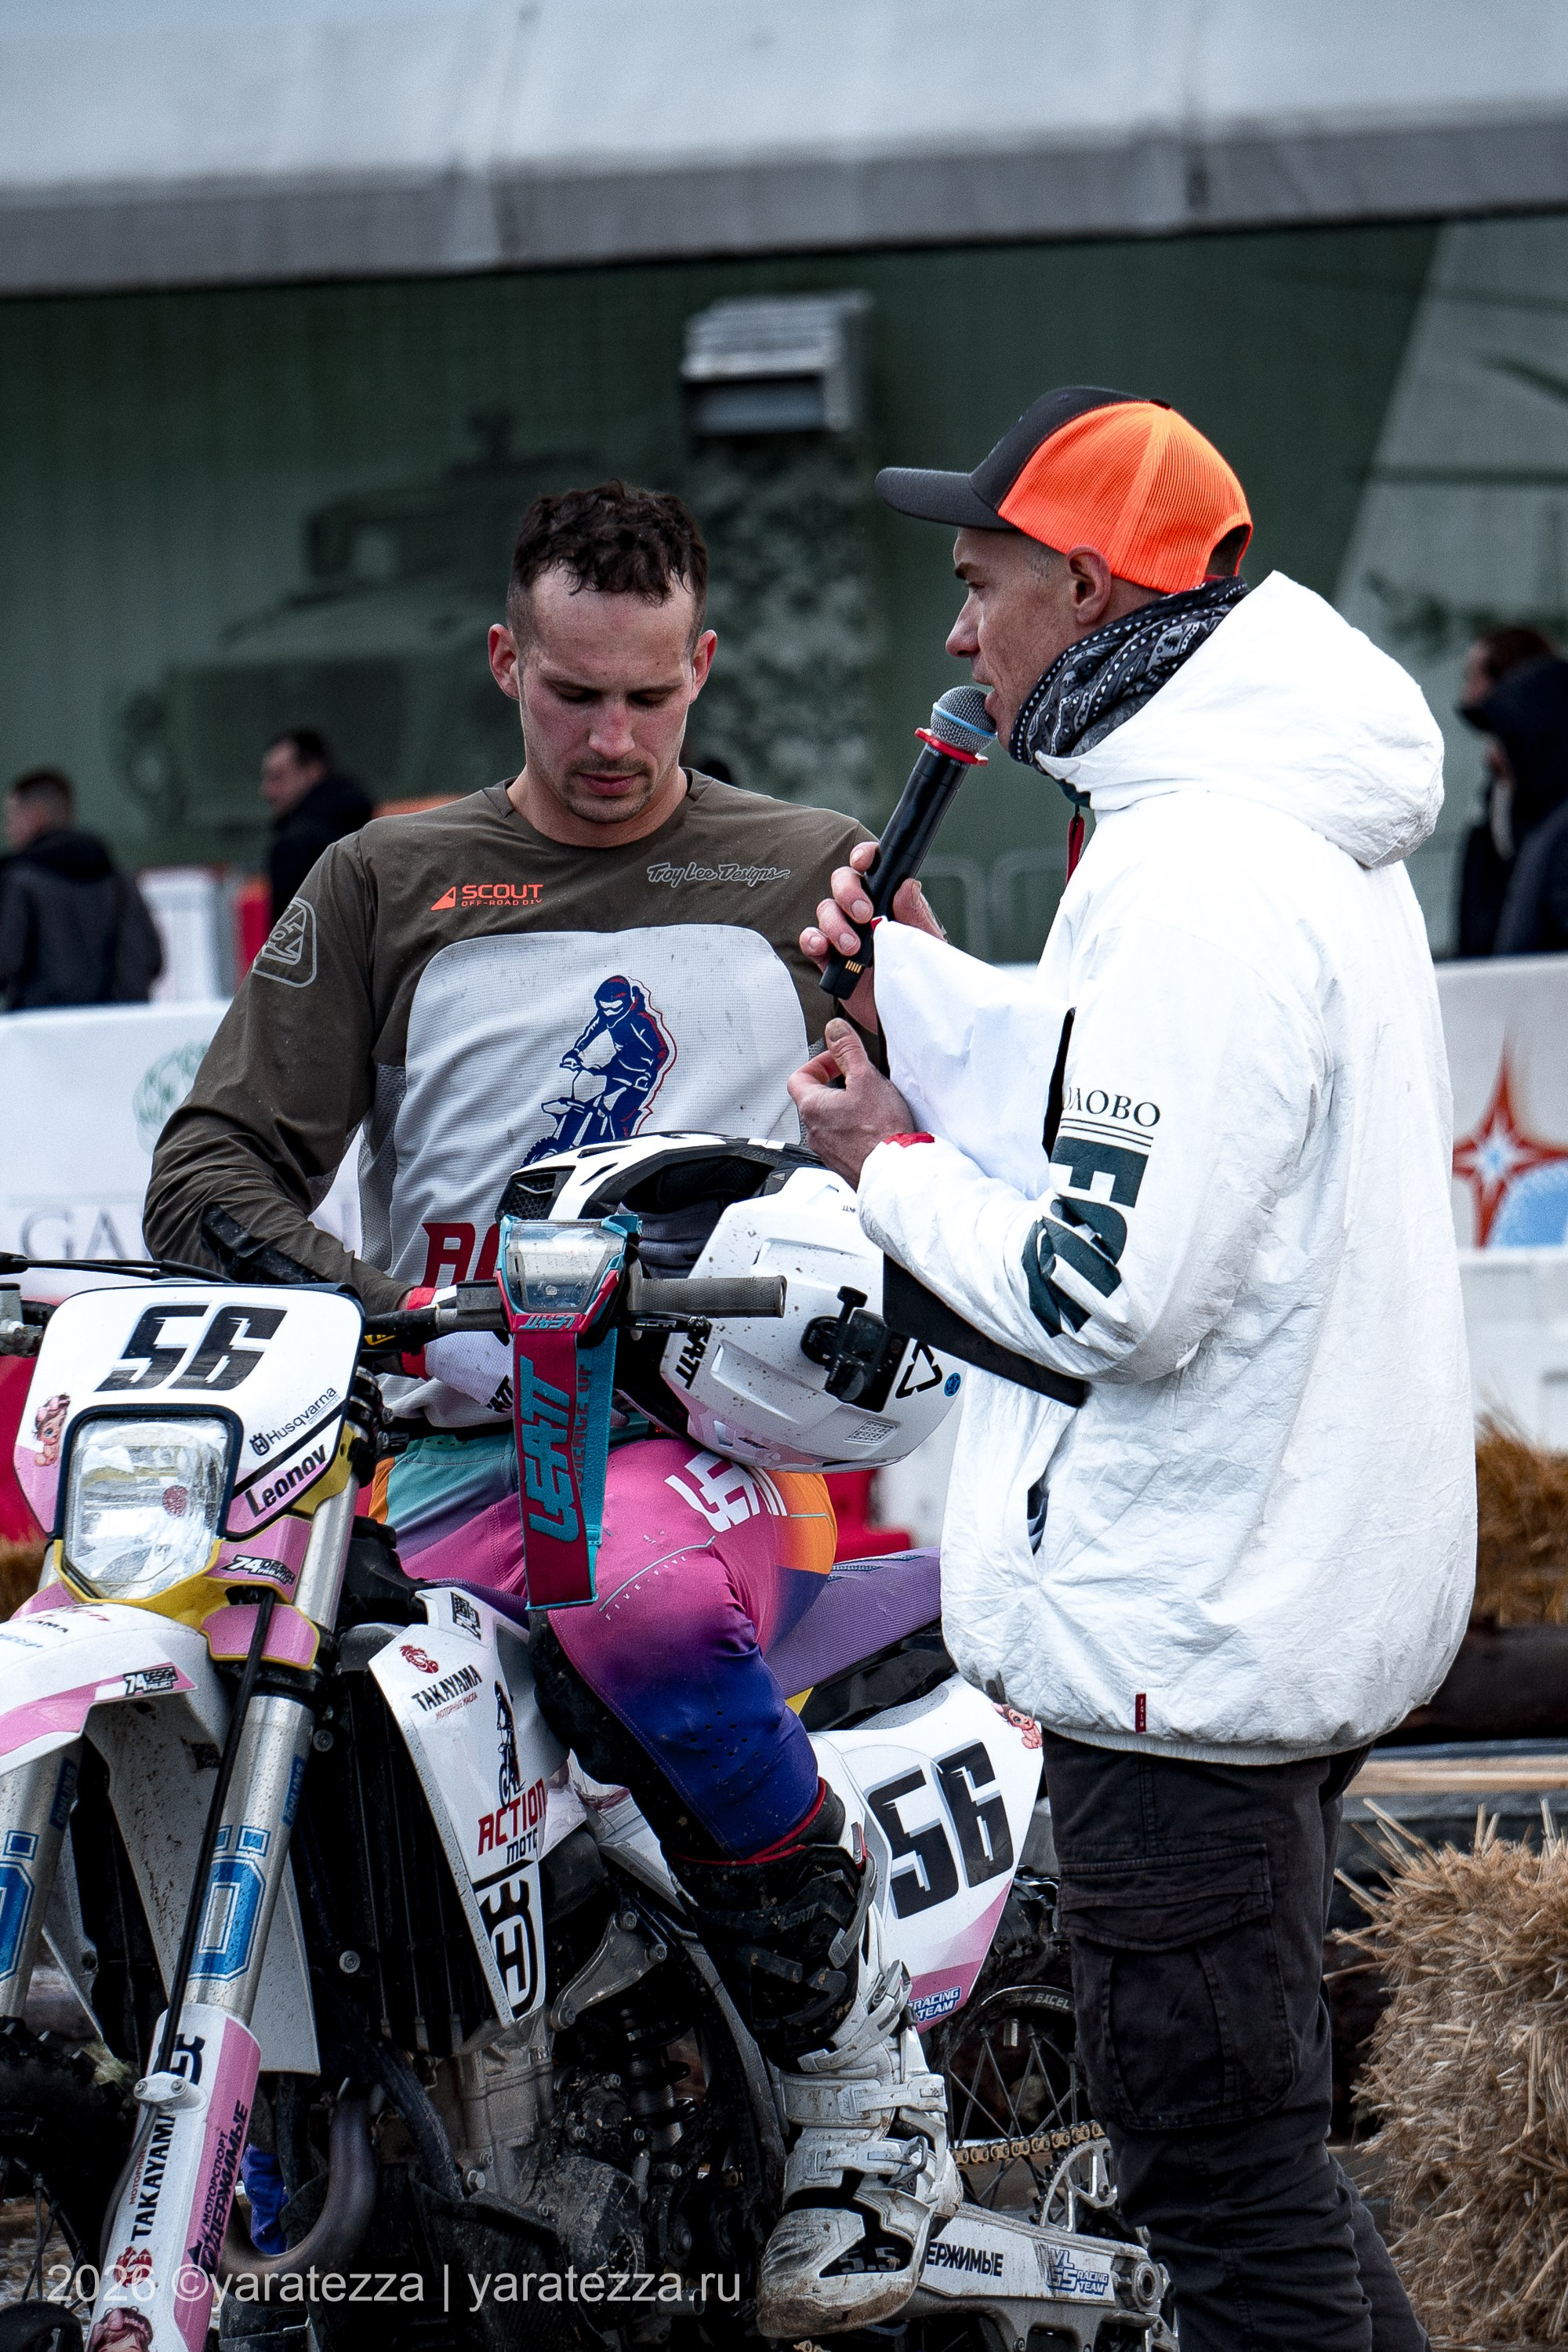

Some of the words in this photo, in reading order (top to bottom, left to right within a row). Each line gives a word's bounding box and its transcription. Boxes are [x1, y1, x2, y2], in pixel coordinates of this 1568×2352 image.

[647, 862, 685, 887] Troy
[686, 862, 717, 882] Lee
[717, 863, 789, 887] Designs
[462, 883, 543, 900] SCOUT
[519, 1314, 576, 1330] LEATT
[93, 1301, 289, 1392] 56
[267, 1387, 338, 1446] Husqvarna
[519, 1354, 579, 1543] LEATT
[244, 1444, 328, 1519] Leonov
[226, 1555, 264, 1573] 74
[125, 1673, 147, 1694] 74
[411, 1664, 483, 1711] TAKAYAMA
[477, 1777, 546, 1857] ACTION
[862, 1738, 1014, 1920] 56
[909, 1987, 960, 2013] RACING
[916, 2000, 955, 2023] TEAM
[1033, 1992, 1070, 2010] EXCEL
[925, 2241, 1004, 2278] ЕРЖИМЫЕ
[1076, 2270, 1109, 2286] RACING
[1079, 2281, 1105, 2296] TEAM
